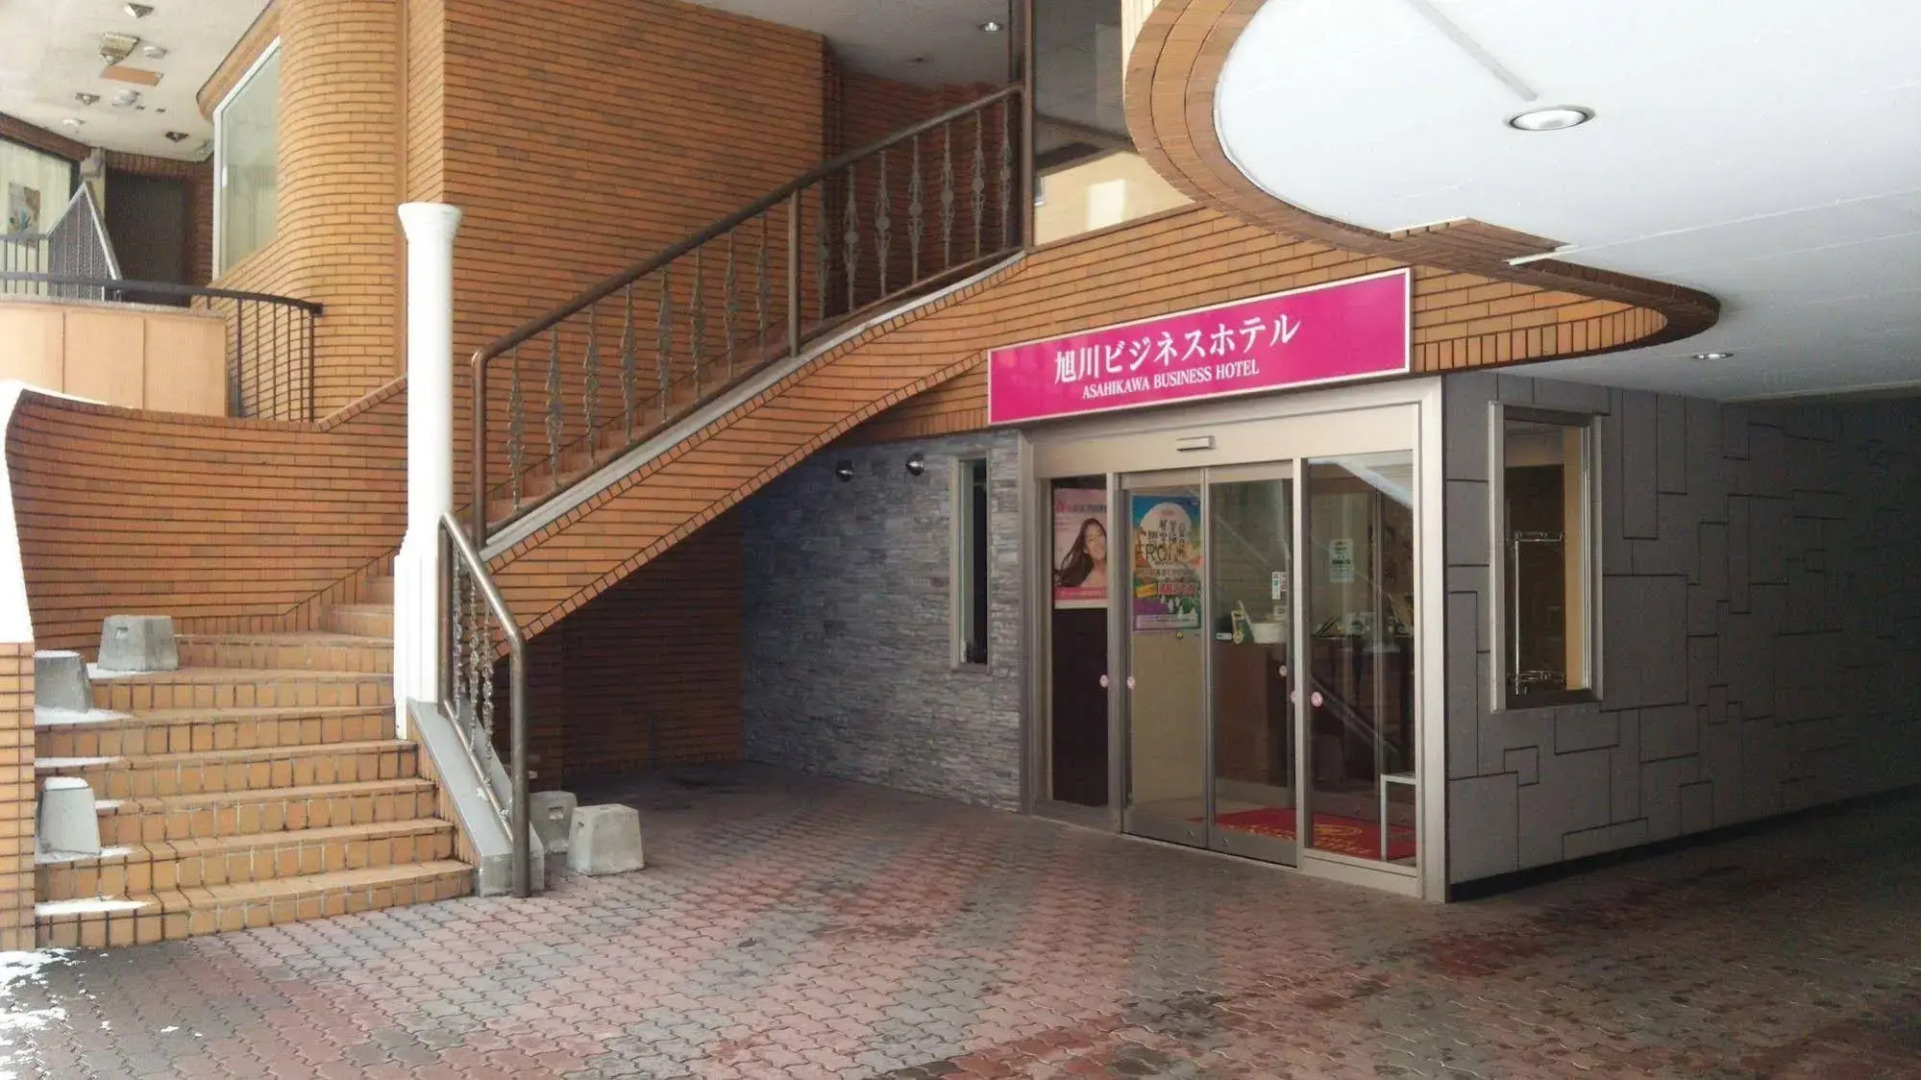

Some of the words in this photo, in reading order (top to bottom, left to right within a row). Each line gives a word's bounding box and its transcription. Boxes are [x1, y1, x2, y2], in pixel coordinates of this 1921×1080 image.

[1054, 314, 1301, 384] 旭川ビジネスホテル
[1082, 378, 1150, 400] ASAHIKAWA
[1153, 365, 1212, 389] BUSINESS
[1215, 358, 1260, 380] HOTEL
